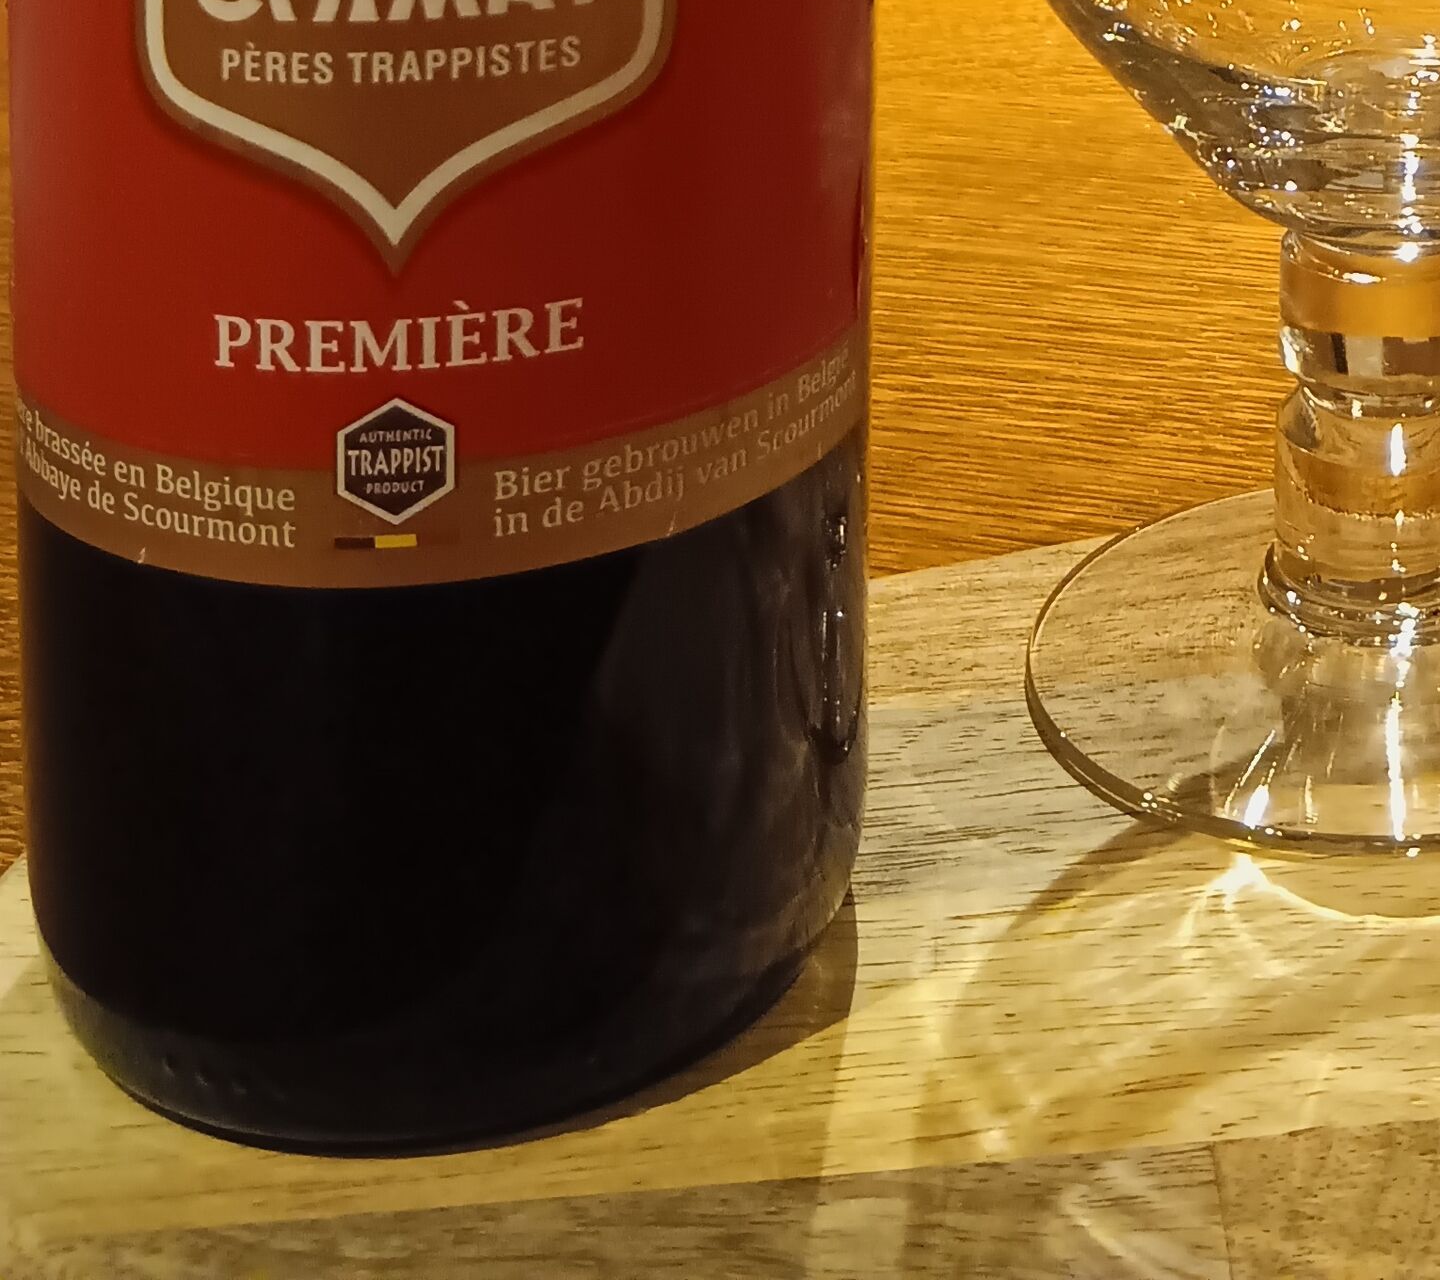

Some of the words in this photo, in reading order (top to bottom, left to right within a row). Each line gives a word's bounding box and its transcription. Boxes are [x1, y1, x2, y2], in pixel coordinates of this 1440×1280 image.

[221, 42, 334, 85] PÈRES
[347, 37, 582, 85] TRAPPISTES
[213, 297, 585, 374] PREMIÈRE
[35, 409, 107, 477] brassée
[114, 460, 146, 488] en
[156, 463, 296, 517] Belgique
[348, 446, 444, 476] TRAPPIST
[359, 428, 432, 443] AUTHENTIC
[494, 464, 571, 500] Bier
[582, 409, 759, 491] gebrouwen
[767, 391, 789, 420] in
[87, 480, 115, 515] de
[124, 491, 297, 548] Scourmont
[366, 480, 424, 494] PRODUCT
[494, 508, 529, 537] in
[542, 497, 584, 528] de
[599, 467, 685, 513] Abdij
[697, 447, 748, 488] van
